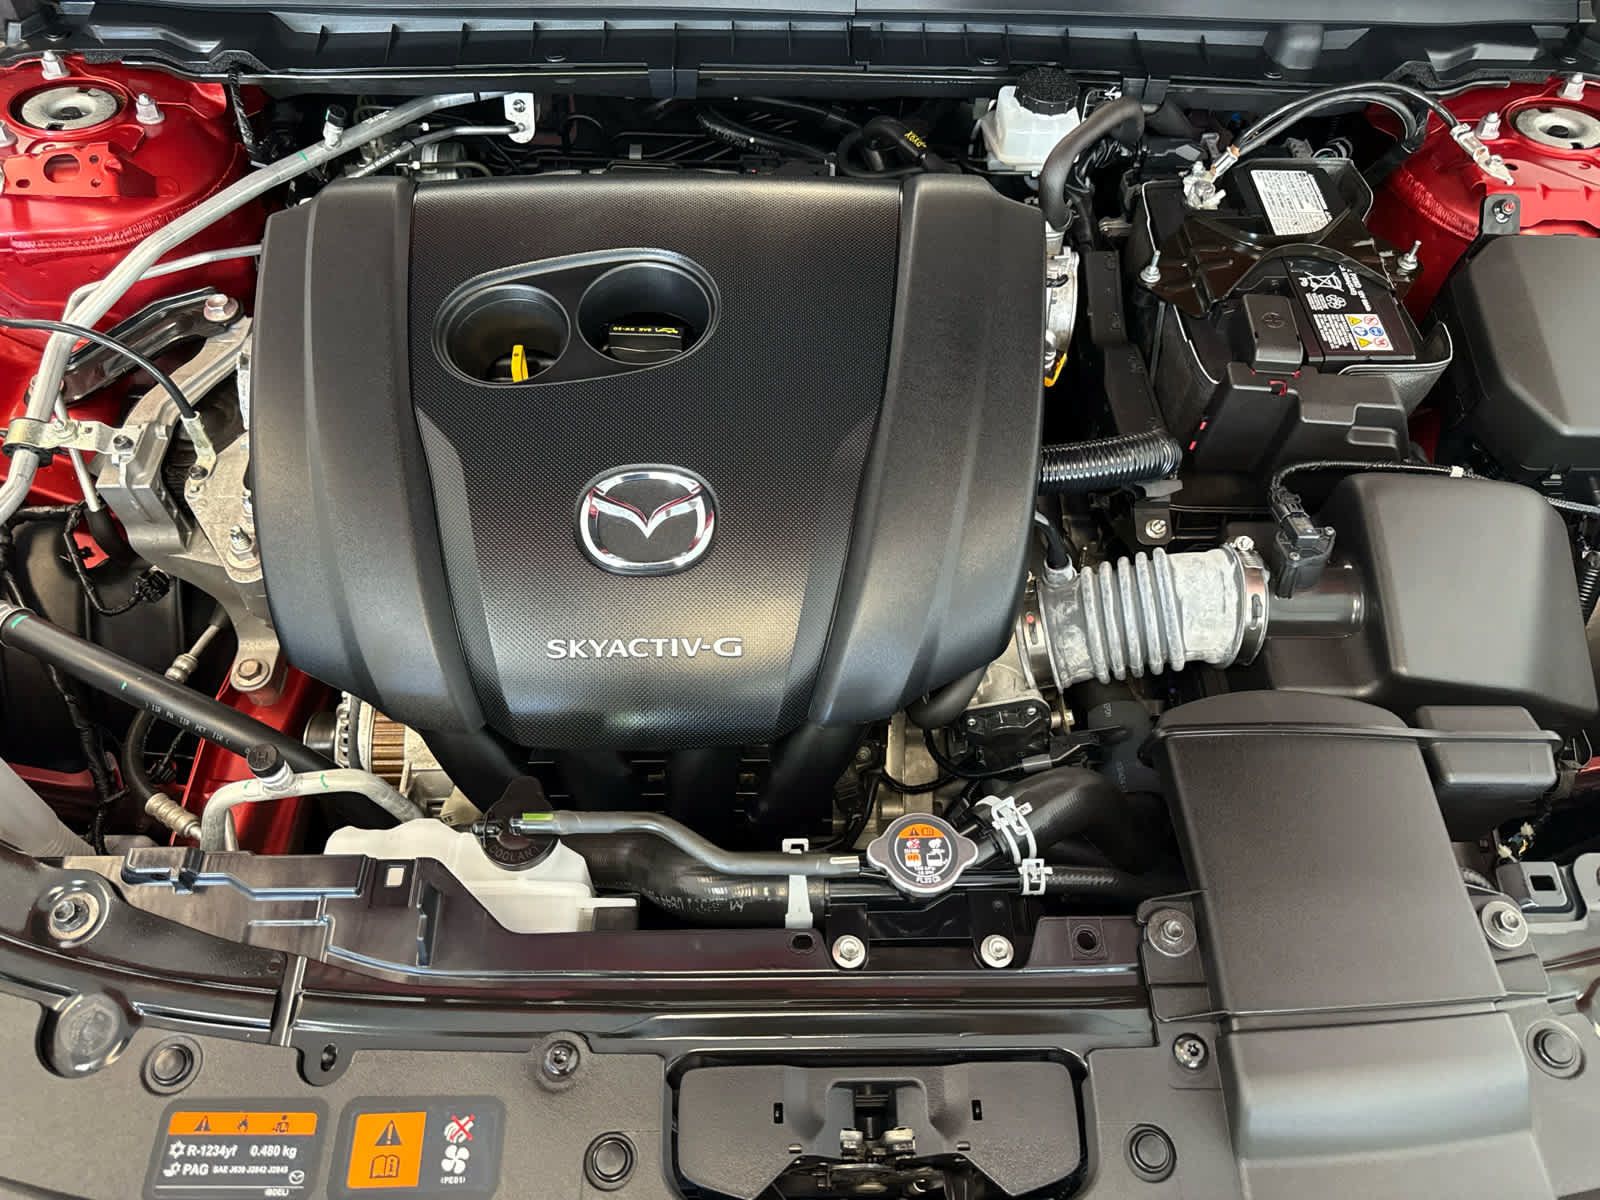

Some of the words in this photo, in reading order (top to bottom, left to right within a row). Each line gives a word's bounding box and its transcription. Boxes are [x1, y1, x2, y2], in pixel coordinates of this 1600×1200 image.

[546, 637, 743, 659] SKYACTIV-G
[186, 1144, 239, 1159] R-1234yf
[249, 1144, 281, 1157] 0.480
[282, 1144, 297, 1159] kg
[182, 1163, 209, 1176] PAG
[212, 1165, 229, 1174] SAE
